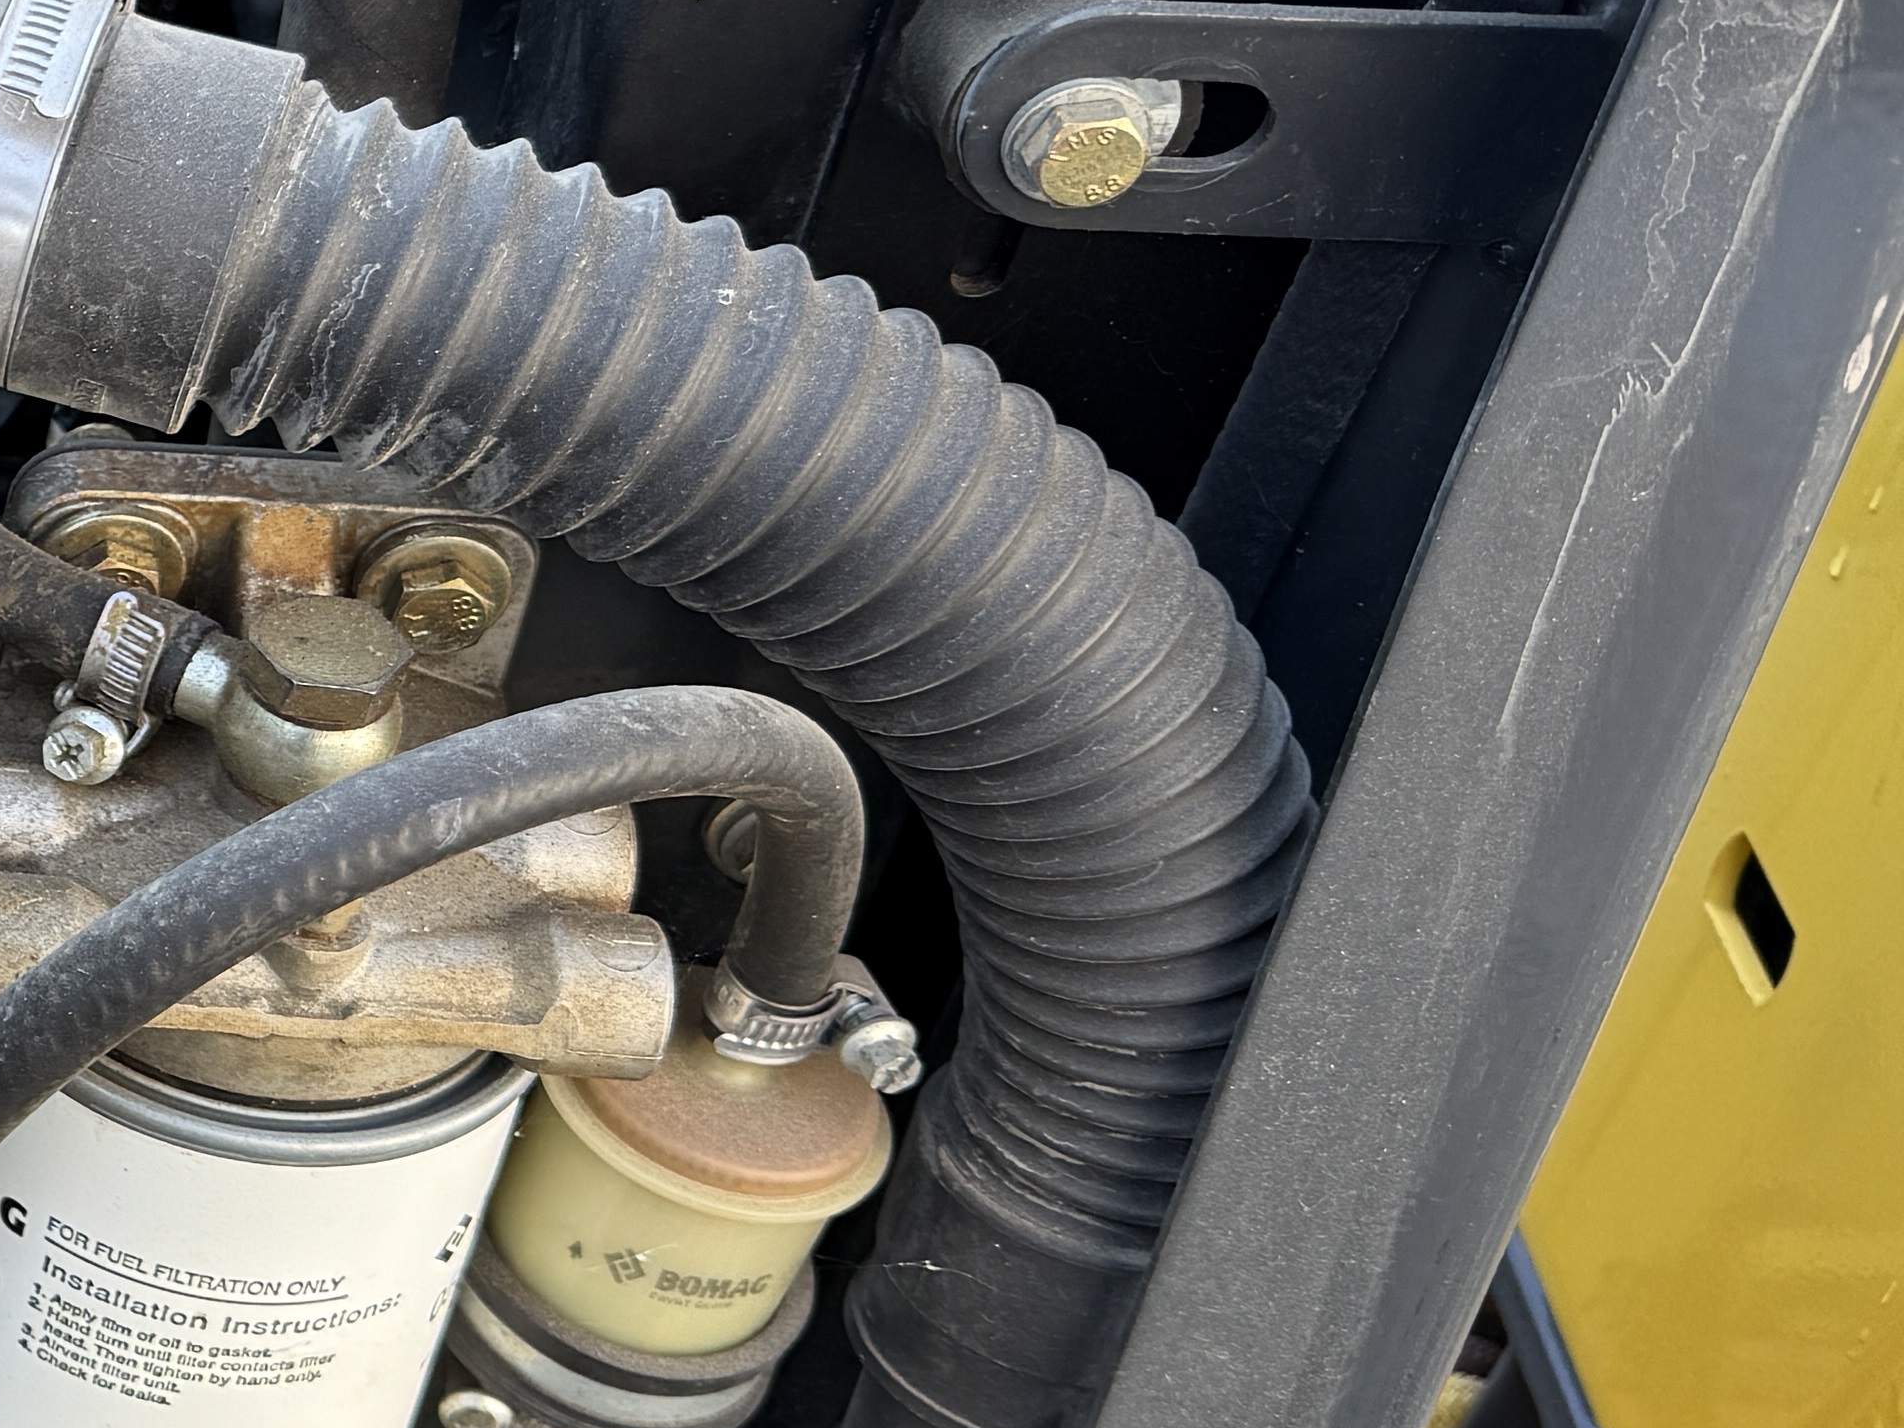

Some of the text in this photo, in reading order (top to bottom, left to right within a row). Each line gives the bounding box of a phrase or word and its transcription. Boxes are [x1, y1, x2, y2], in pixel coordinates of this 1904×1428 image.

[46, 1215, 346, 1296] FOR FUEL FILTRATION ONLY
[653, 1267, 773, 1302] BOMAG
[32, 1281, 47, 1300] 1.
[49, 1292, 98, 1324] Apply
[100, 1316, 132, 1337] film
[136, 1331, 156, 1346] of
[158, 1337, 182, 1350] oil
[185, 1340, 204, 1355] to
[42, 1255, 208, 1331] Installation
[221, 1292, 403, 1336] Instructions:
[19, 1321, 36, 1340] 3.
[38, 1333, 98, 1370] Airvent
[101, 1361, 141, 1383] filter
[35, 1346, 88, 1381] Check
[92, 1372, 117, 1391] for
[42, 1318, 89, 1350] head.
[94, 1341, 139, 1369] Then
[142, 1360, 204, 1382] tighten
[208, 1372, 231, 1388] by
[235, 1374, 281, 1387] hand
[46, 1306, 91, 1337] Hand
[95, 1329, 130, 1351] turn
[133, 1343, 173, 1364] until
[176, 1352, 217, 1370] filter
[220, 1358, 295, 1373] contacts
[299, 1352, 336, 1370] filter
